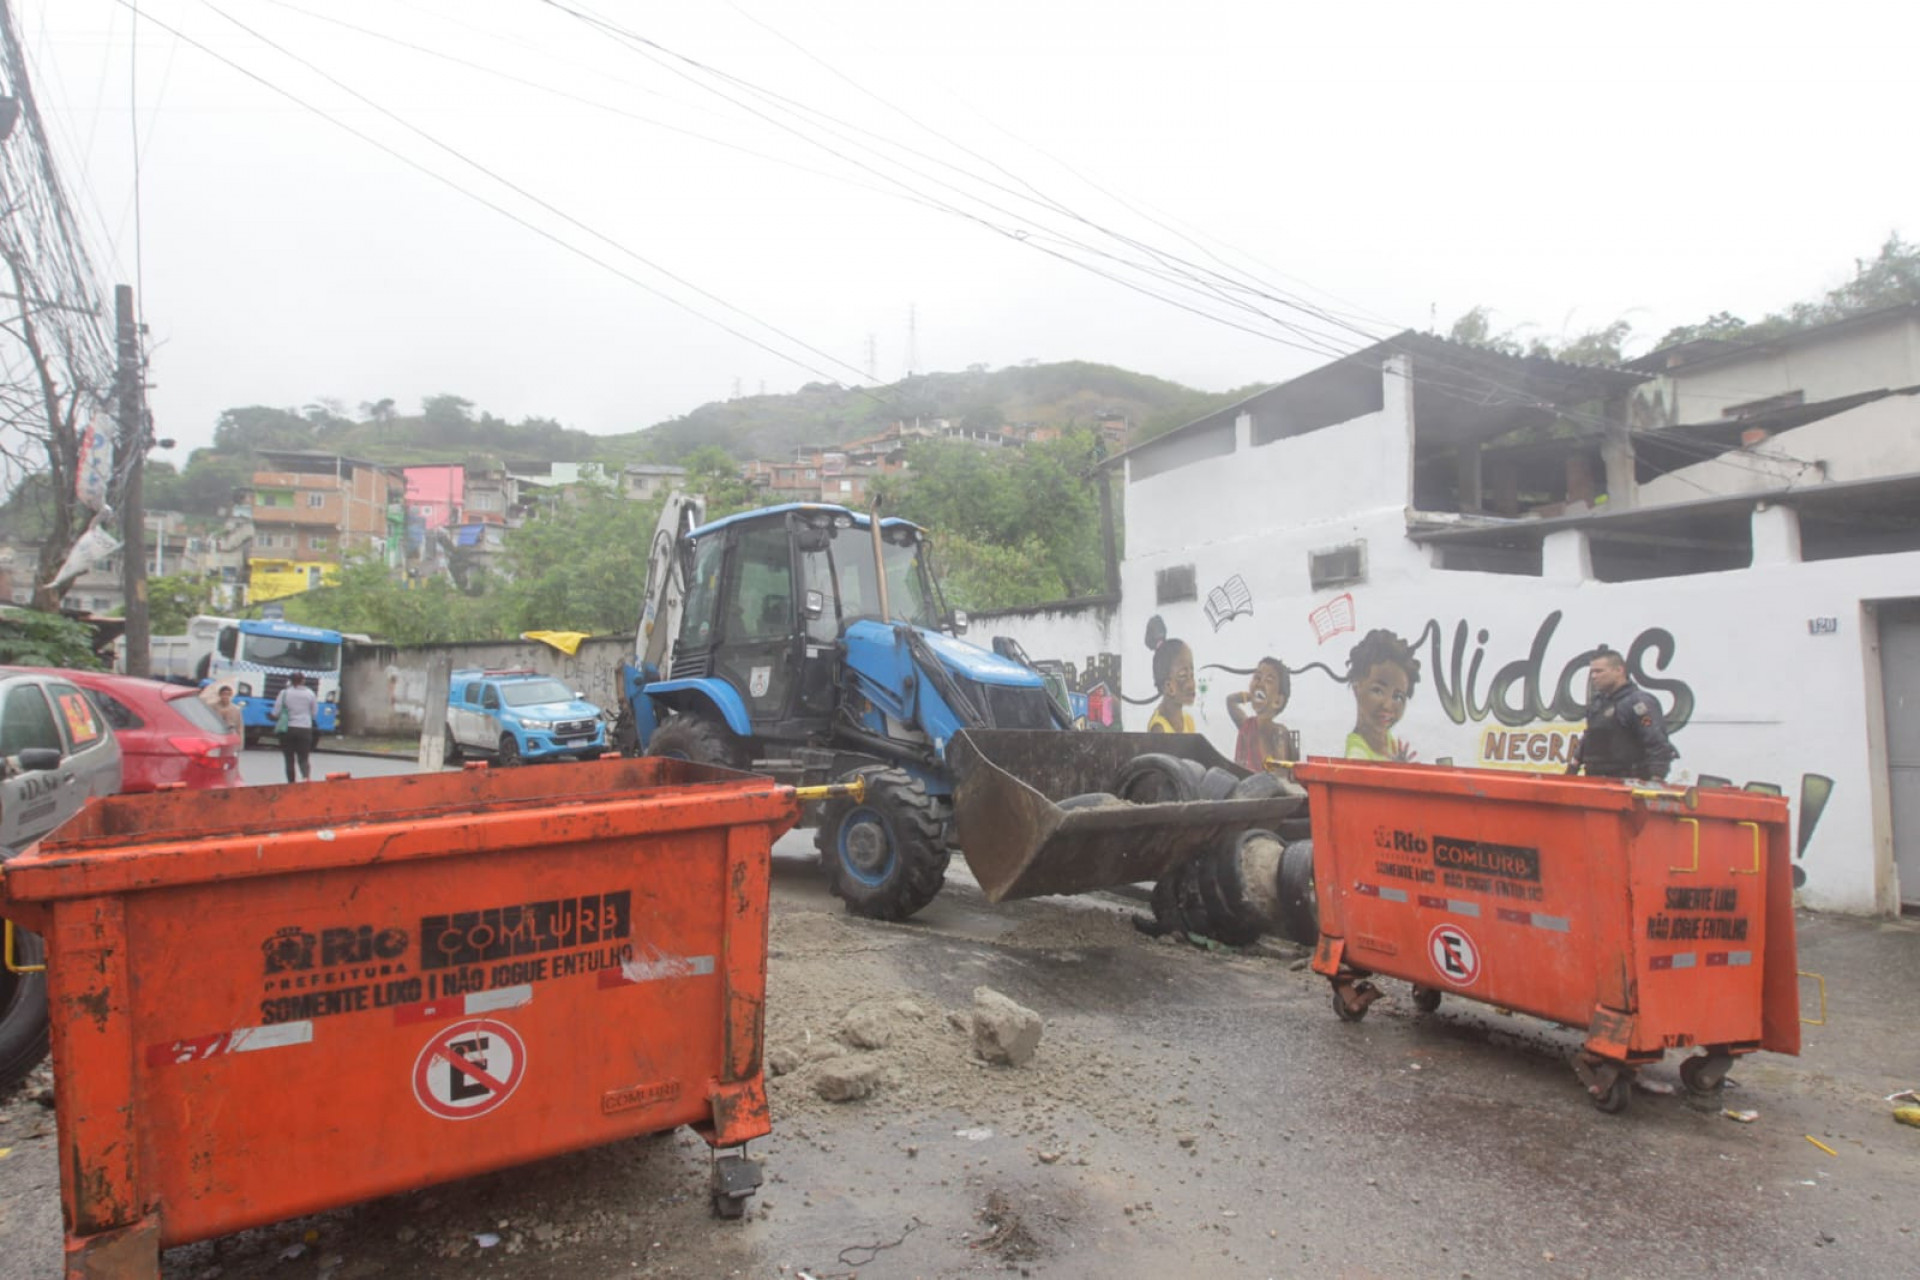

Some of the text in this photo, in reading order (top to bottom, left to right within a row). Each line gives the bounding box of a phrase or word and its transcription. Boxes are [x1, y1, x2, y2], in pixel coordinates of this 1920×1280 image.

[1416, 610, 1695, 734] Vidas
[1484, 732, 1581, 764] NEGRA
[1393, 829, 1528, 875] Rio COMLURB
[322, 900, 622, 967] Rio COMLURB
[261, 985, 369, 1025] SOMENTE
[373, 977, 422, 1007] LIXO
[442, 966, 485, 996] NÃO
[489, 957, 548, 990] JOGUE
[551, 942, 634, 979] ENTULHO
[264, 963, 408, 992] PREFEITURA
[449, 1036, 490, 1102] E
